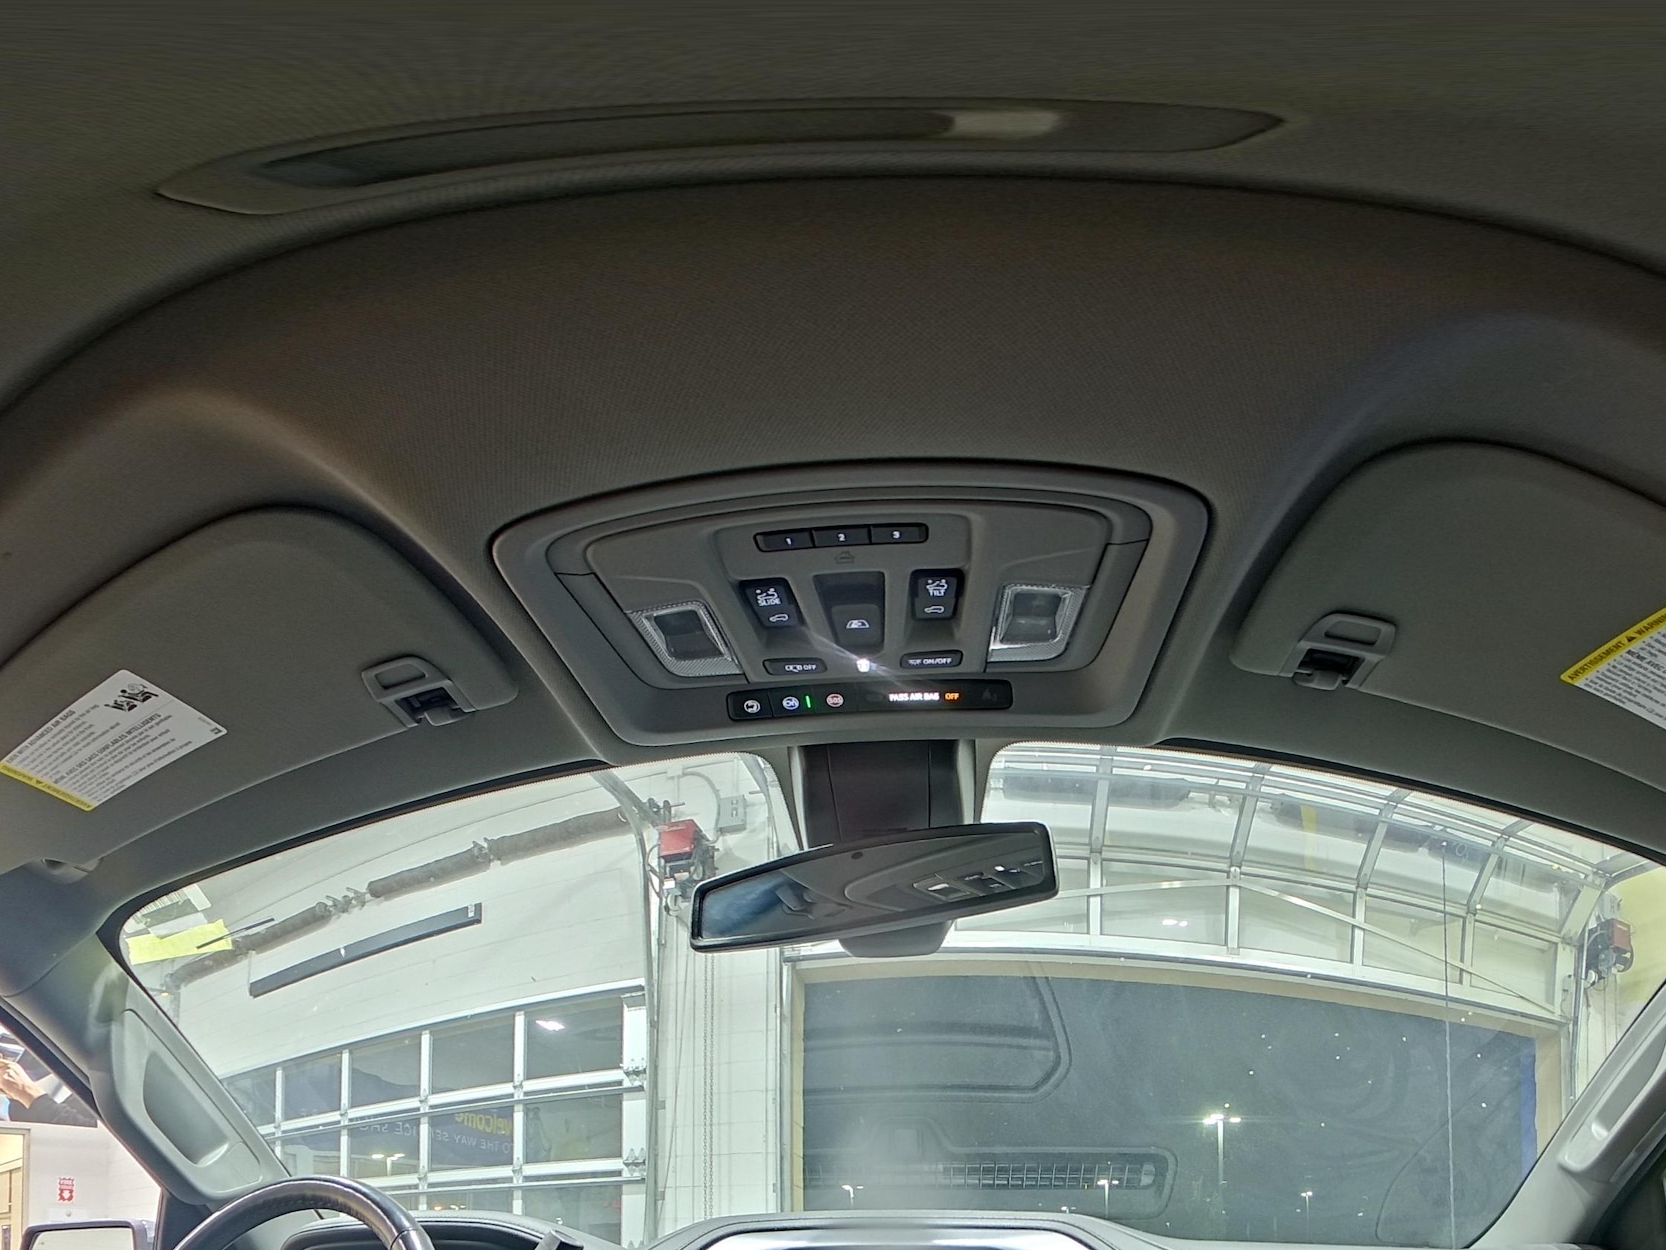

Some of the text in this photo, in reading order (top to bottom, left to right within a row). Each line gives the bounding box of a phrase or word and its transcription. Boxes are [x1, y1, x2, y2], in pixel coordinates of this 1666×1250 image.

[838, 533, 845, 542] 2
[893, 531, 900, 539] 3
[786, 537, 792, 545] 1
[928, 589, 946, 597] TILT
[758, 597, 781, 606] SLIDE
[923, 657, 952, 665] ON/OFF
[889, 692, 959, 701] PASS AIR BAG OFF
